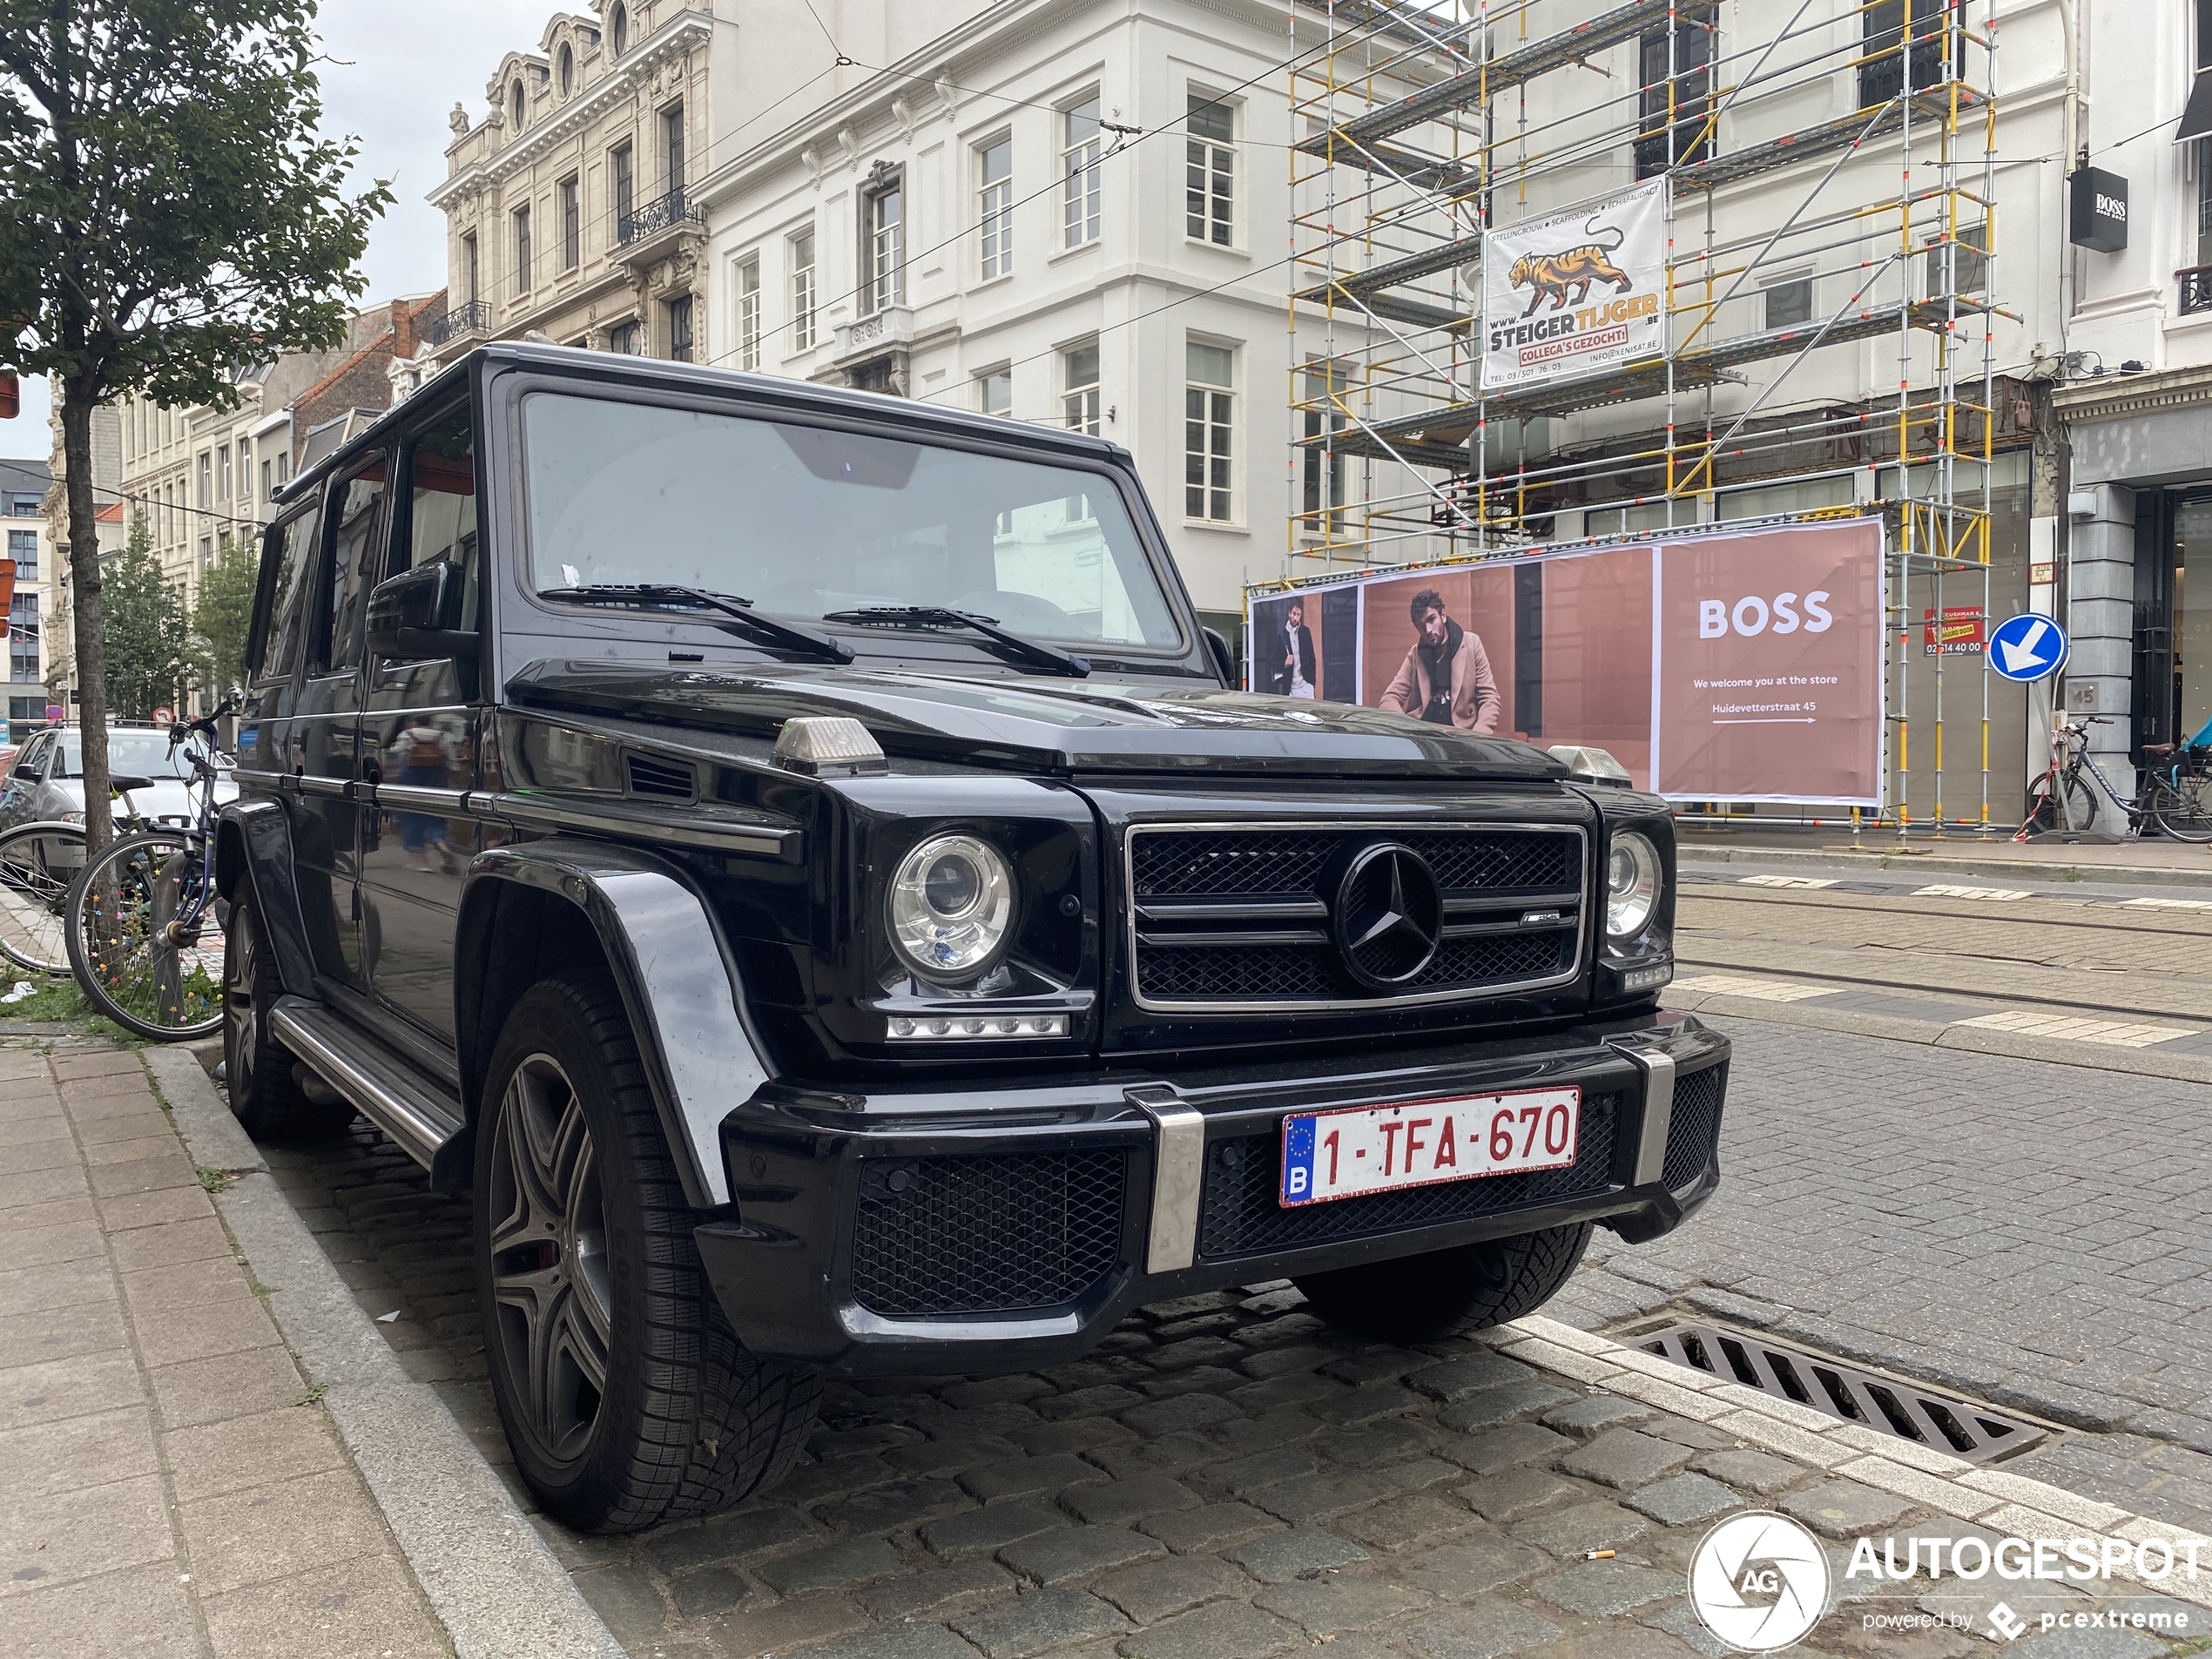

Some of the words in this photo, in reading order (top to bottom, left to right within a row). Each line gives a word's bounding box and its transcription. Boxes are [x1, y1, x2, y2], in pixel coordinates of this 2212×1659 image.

[1491, 222, 1544, 242] STELLINGBOUW
[1551, 206, 1599, 226] SCAFFOLDING
[1608, 185, 1660, 210] ÉCHAFAUDAGE
[2096, 192, 2126, 217] BOSS
[1521, 342, 1572, 362] COLLEGA'S
[1573, 330, 1626, 349] GEZOCHT!
[1589, 340, 1657, 362] INFO@XENISAT.BE
[1491, 374, 1505, 383] TEL:
[1700, 590, 1833, 638] BOSS
[1955, 643, 1966, 652] 40
[1968, 643, 1980, 651] 00
[1693, 679, 1709, 688] We
[1710, 678, 1753, 688] welcome
[1755, 678, 1774, 688] you
[1789, 676, 1807, 685] the
[1810, 676, 1838, 685] store
[1712, 702, 1800, 713] Huidevetterstraat
[1803, 702, 1817, 711] 45
[2074, 690, 2094, 704] 45
[1324, 1103, 1568, 1185] 1-TFA-670
[1290, 1166, 1307, 1194] B
